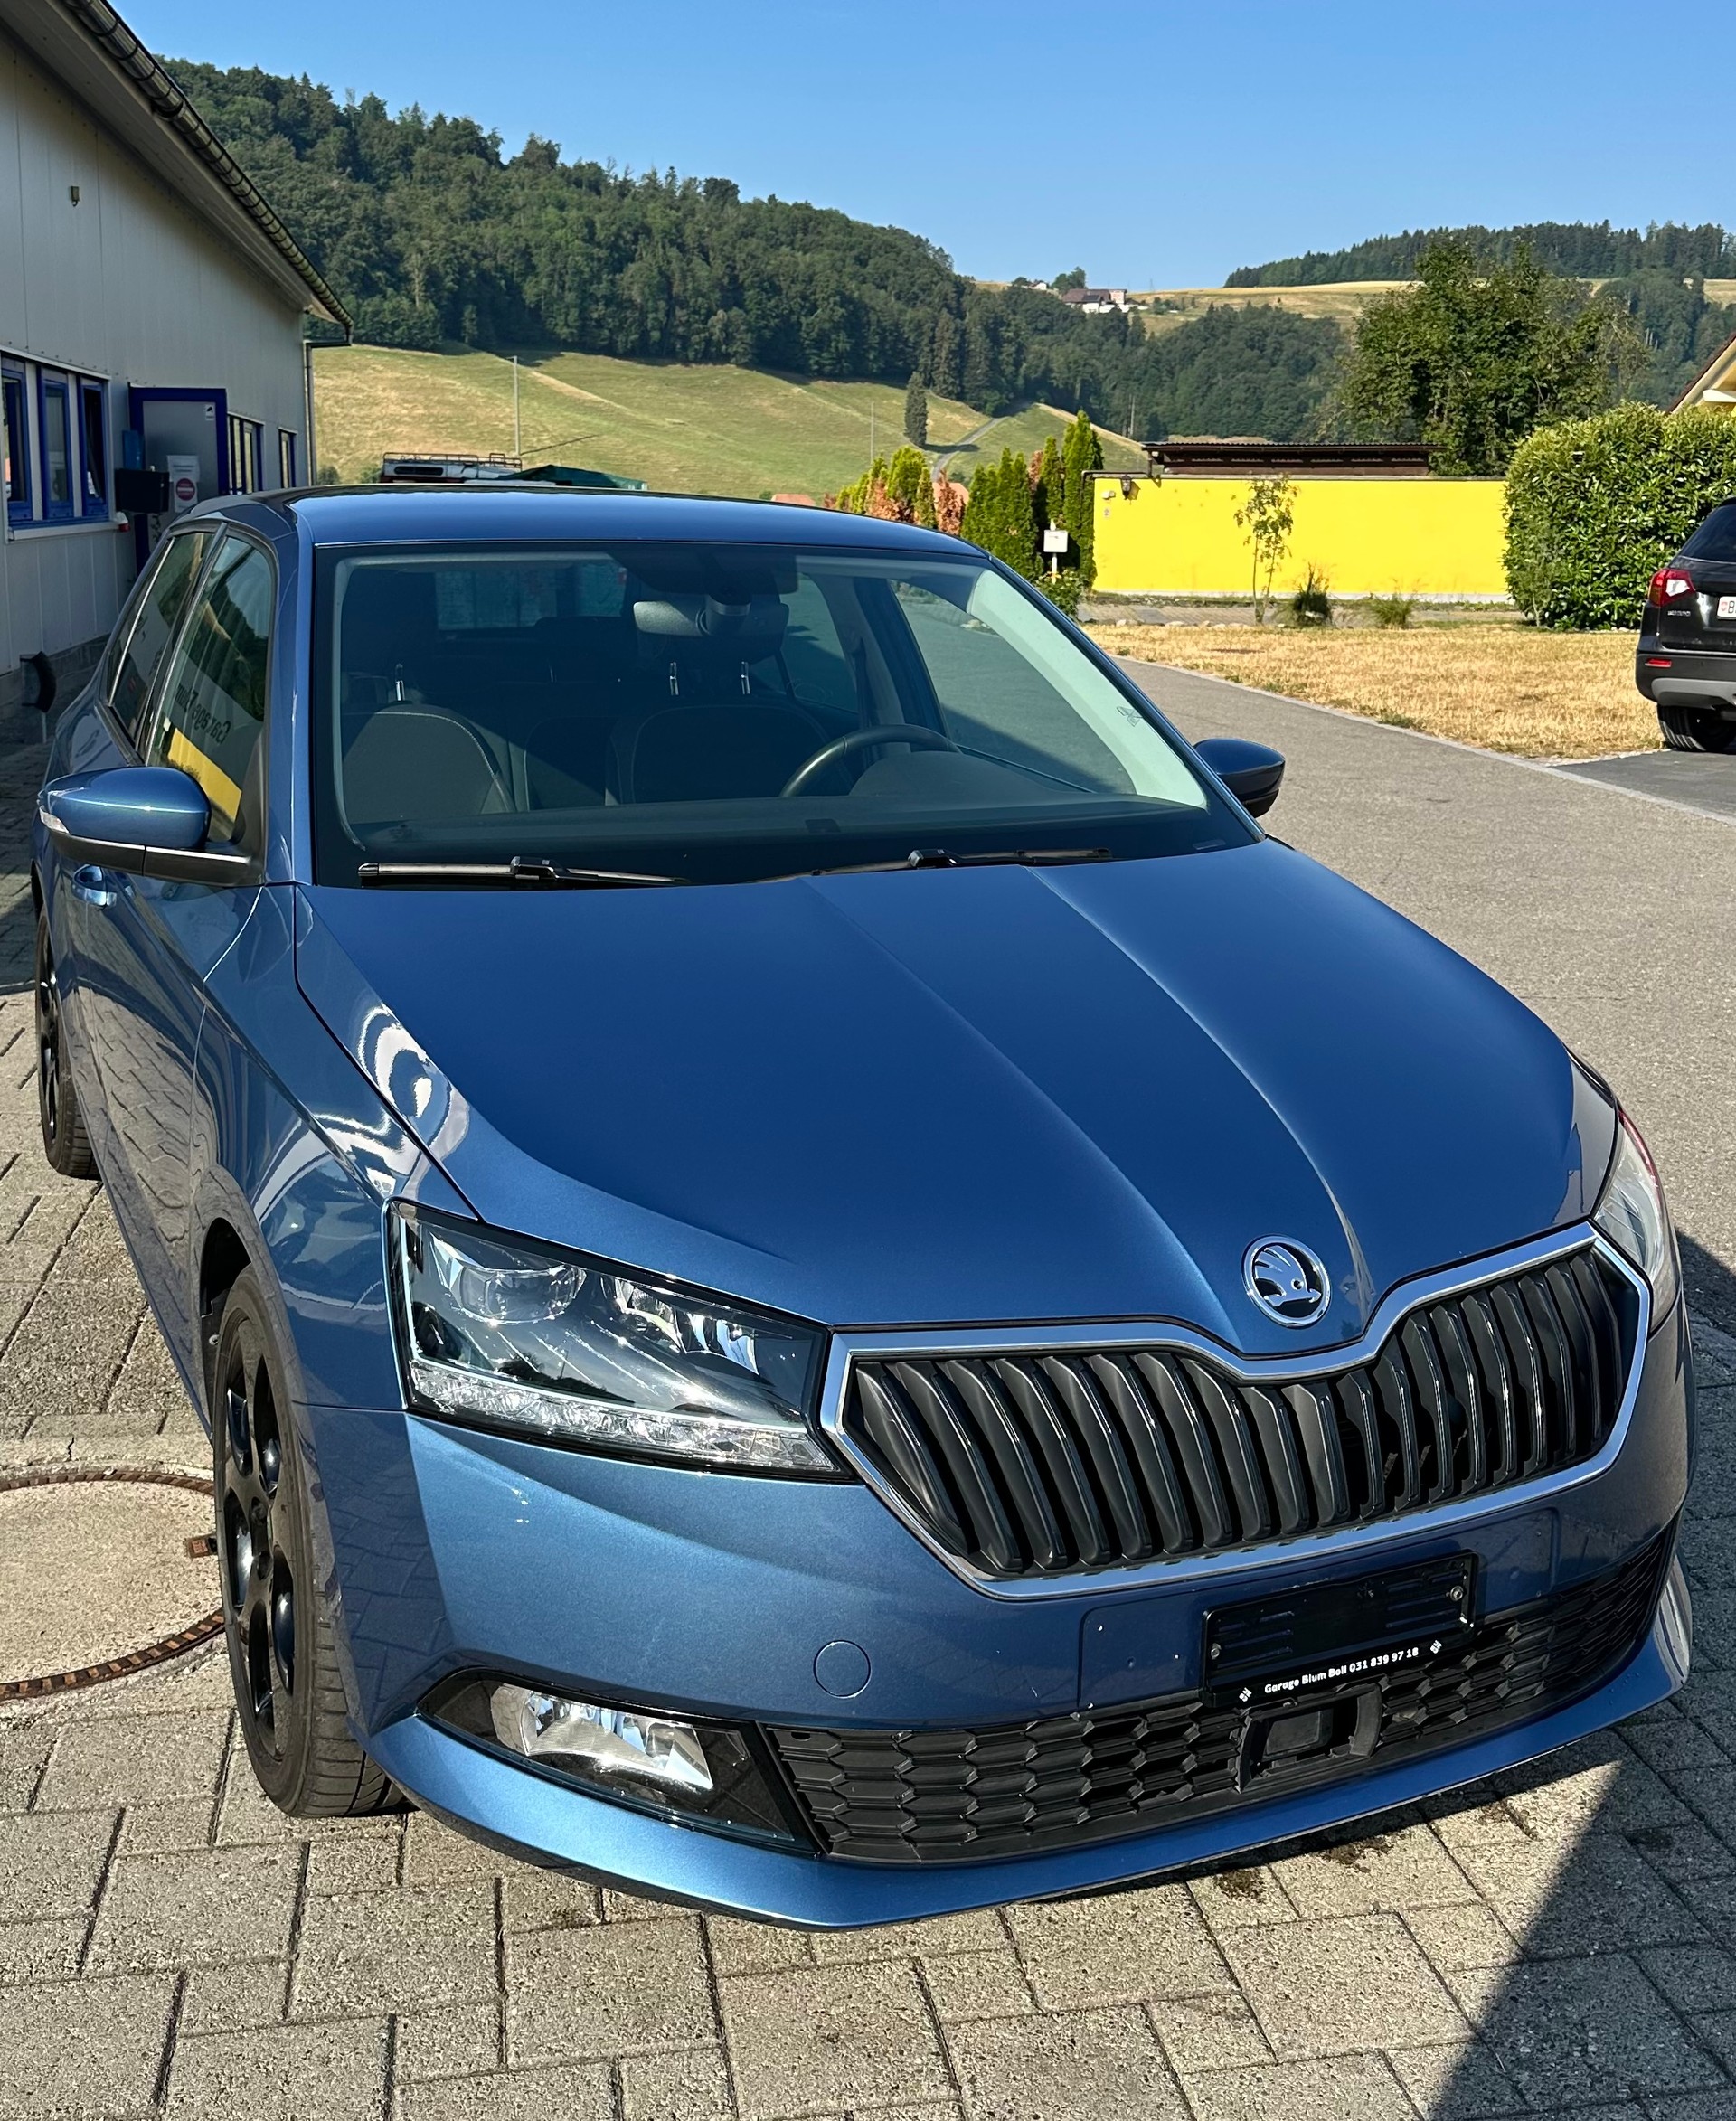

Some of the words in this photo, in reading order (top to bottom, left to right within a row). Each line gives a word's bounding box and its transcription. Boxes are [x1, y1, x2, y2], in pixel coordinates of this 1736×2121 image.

[1728, 600, 1736, 614] B
[1264, 1679, 1299, 1693] Garage
[1301, 1672, 1326, 1684] Blum
[1327, 1664, 1347, 1678] Boll
[1349, 1660, 1369, 1673] 031
[1370, 1654, 1390, 1667] 839
[1392, 1650, 1404, 1662] 97
[1406, 1647, 1419, 1658] 18
